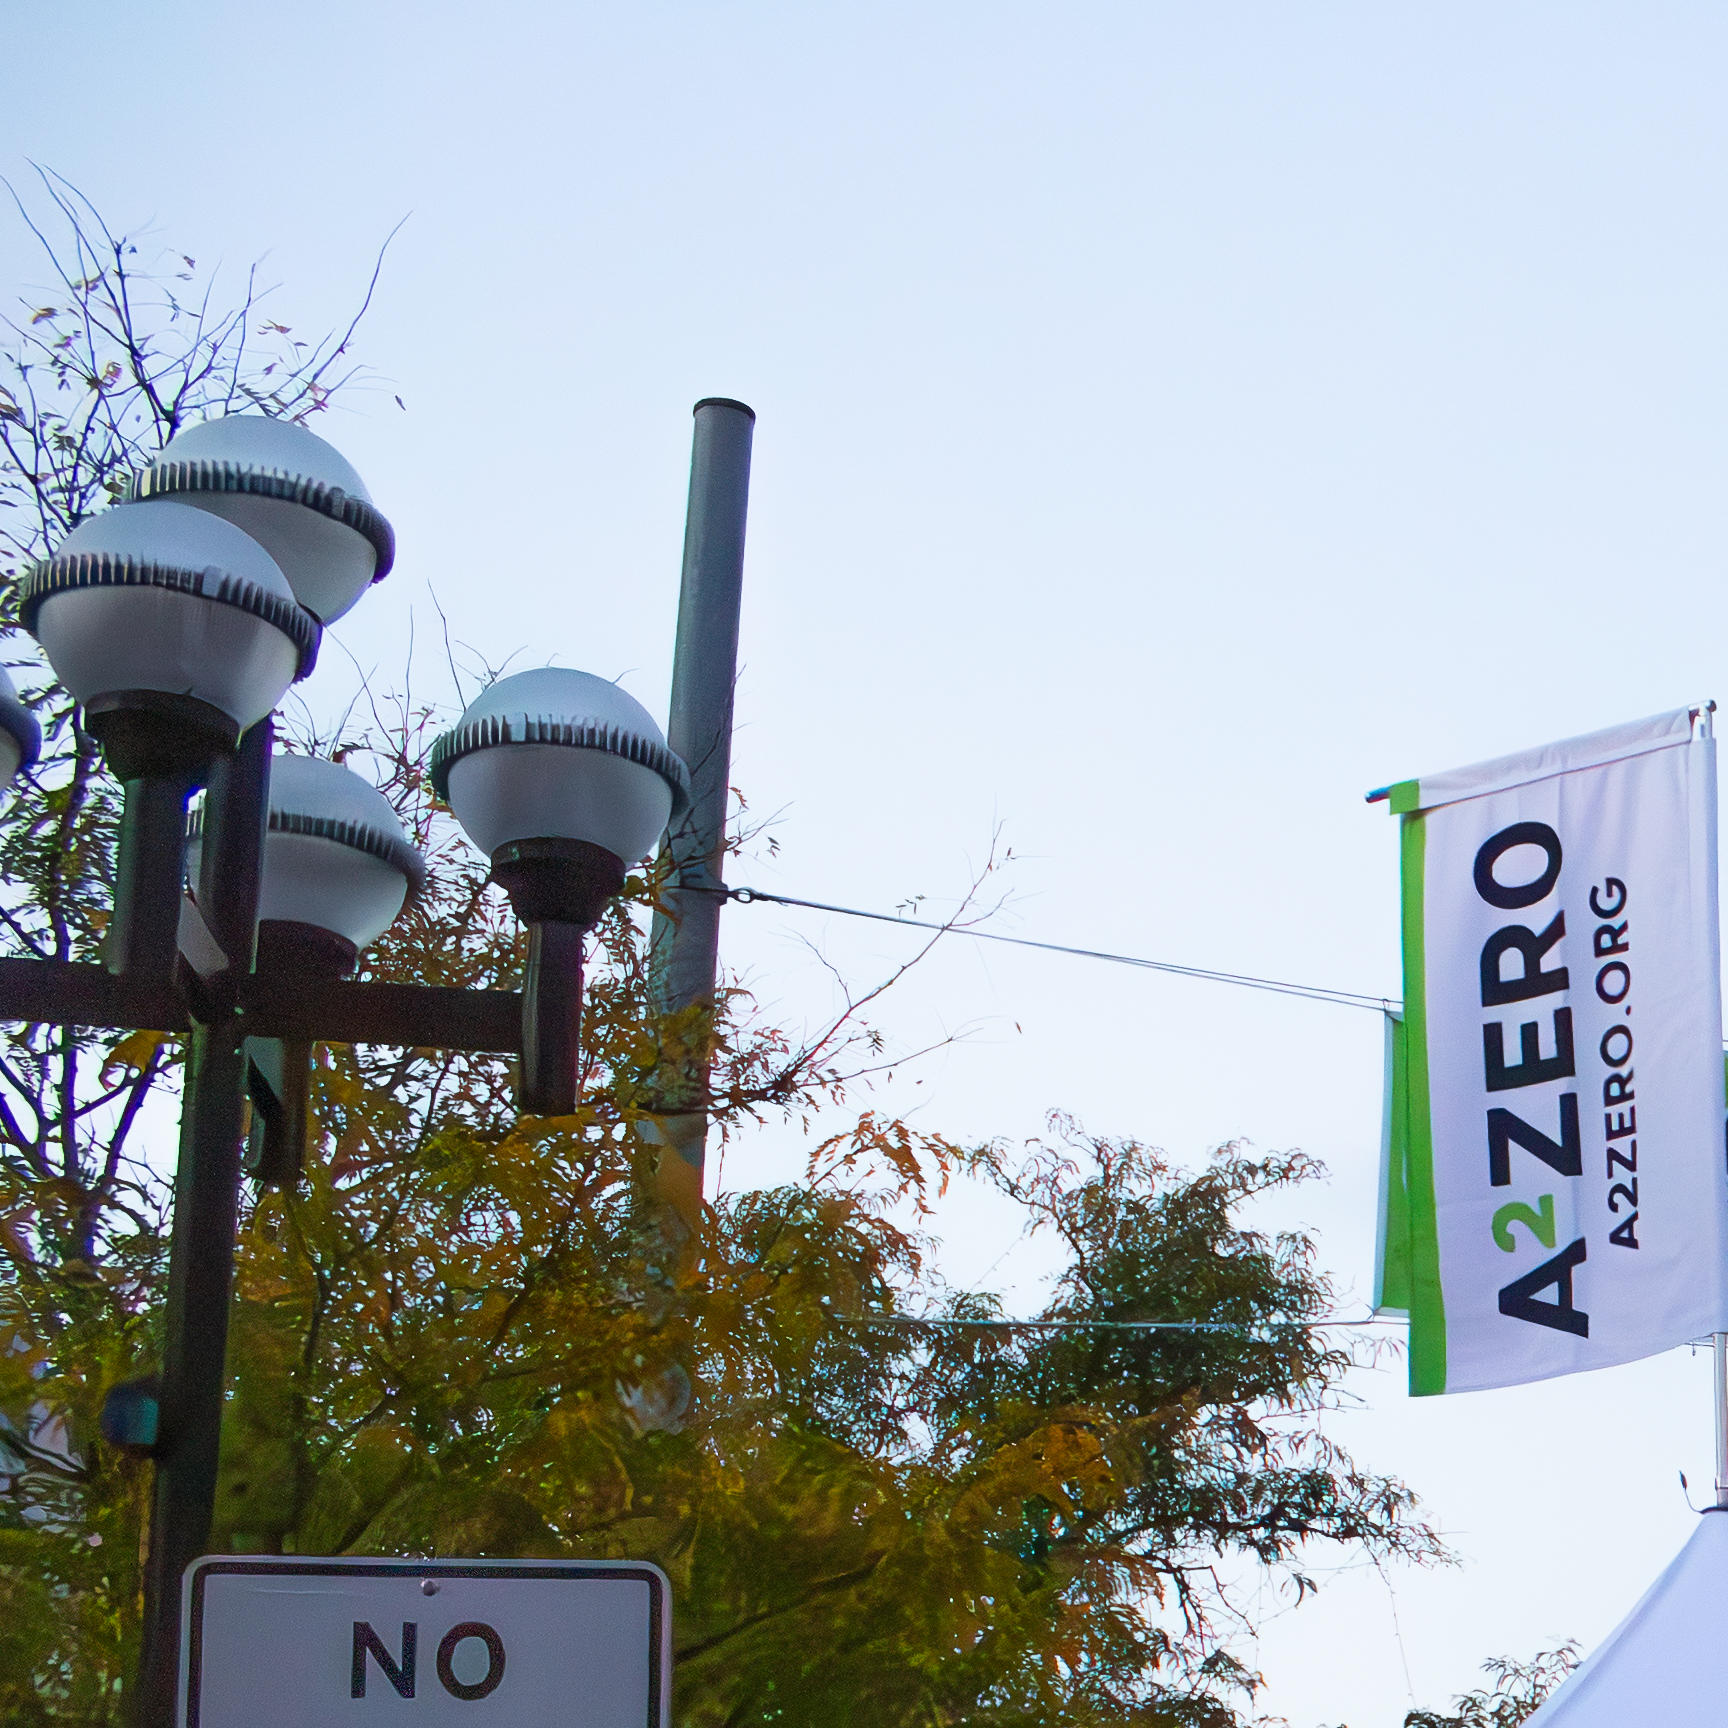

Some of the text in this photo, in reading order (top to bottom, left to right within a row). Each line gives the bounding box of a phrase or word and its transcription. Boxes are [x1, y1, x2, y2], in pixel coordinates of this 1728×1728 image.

[1472, 819, 1590, 1338] A2ZERO
[1590, 876, 1640, 1250] A2ZERO.ORG
[351, 1621, 506, 1700] NO
